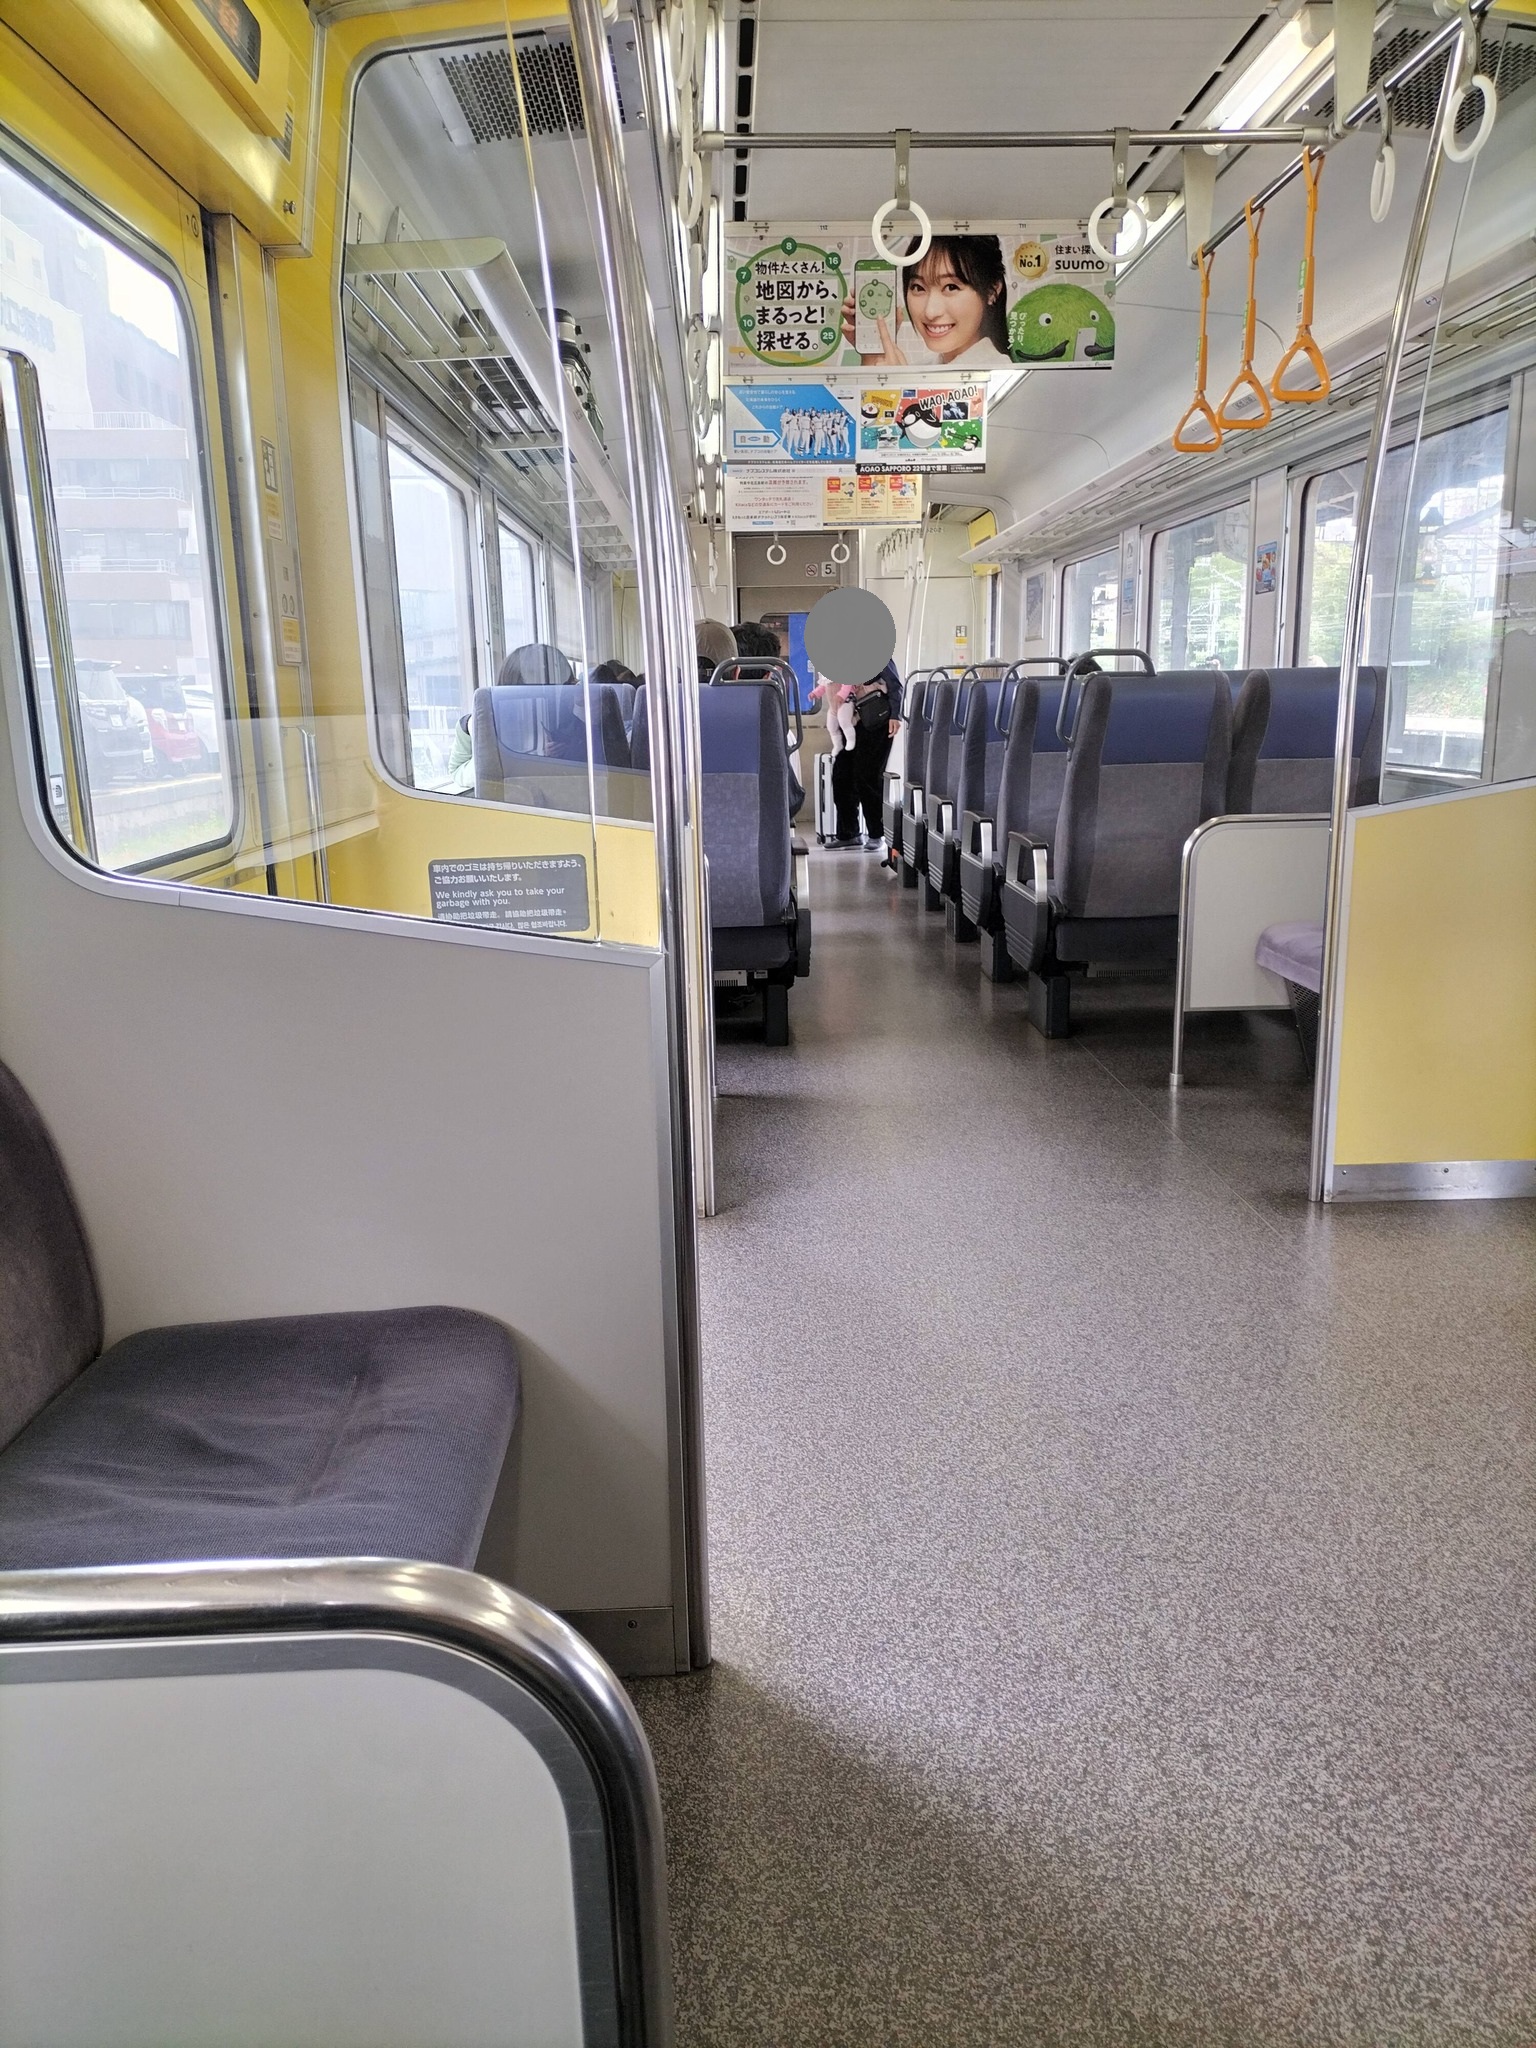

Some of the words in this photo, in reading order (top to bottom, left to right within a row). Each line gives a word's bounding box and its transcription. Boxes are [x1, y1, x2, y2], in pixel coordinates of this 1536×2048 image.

[786, 242, 792, 250] 8
[828, 256, 839, 265] 16
[1019, 254, 1042, 268] No.1
[755, 261, 826, 275] 物件たくさん！
[740, 272, 747, 280] 7
[755, 280, 838, 301] 地図から、
[756, 305, 826, 325] まるっと！
[742, 319, 753, 328] 10
[756, 331, 819, 352] 探せる。
[822, 331, 834, 341] 25
[920, 395, 946, 410] WAO!
[947, 385, 978, 402] AOAO!
[859, 465, 880, 473] AOAO
[825, 563, 832, 575] 5
[432, 859, 582, 873] 車内でのゴミは持ち帰りいただきますよう、
[434, 873, 523, 885] ご協力お願いいたします。
[435, 891, 450, 899] We
[452, 889, 478, 900] kindly
[480, 888, 494, 897] ask
[497, 889, 512, 898] you
[514, 888, 524, 896] to
[525, 888, 544, 896] take
[546, 888, 565, 897] your
[436, 899, 470, 909] garbage
[472, 898, 490, 906] with
[493, 899, 511, 907] you.
